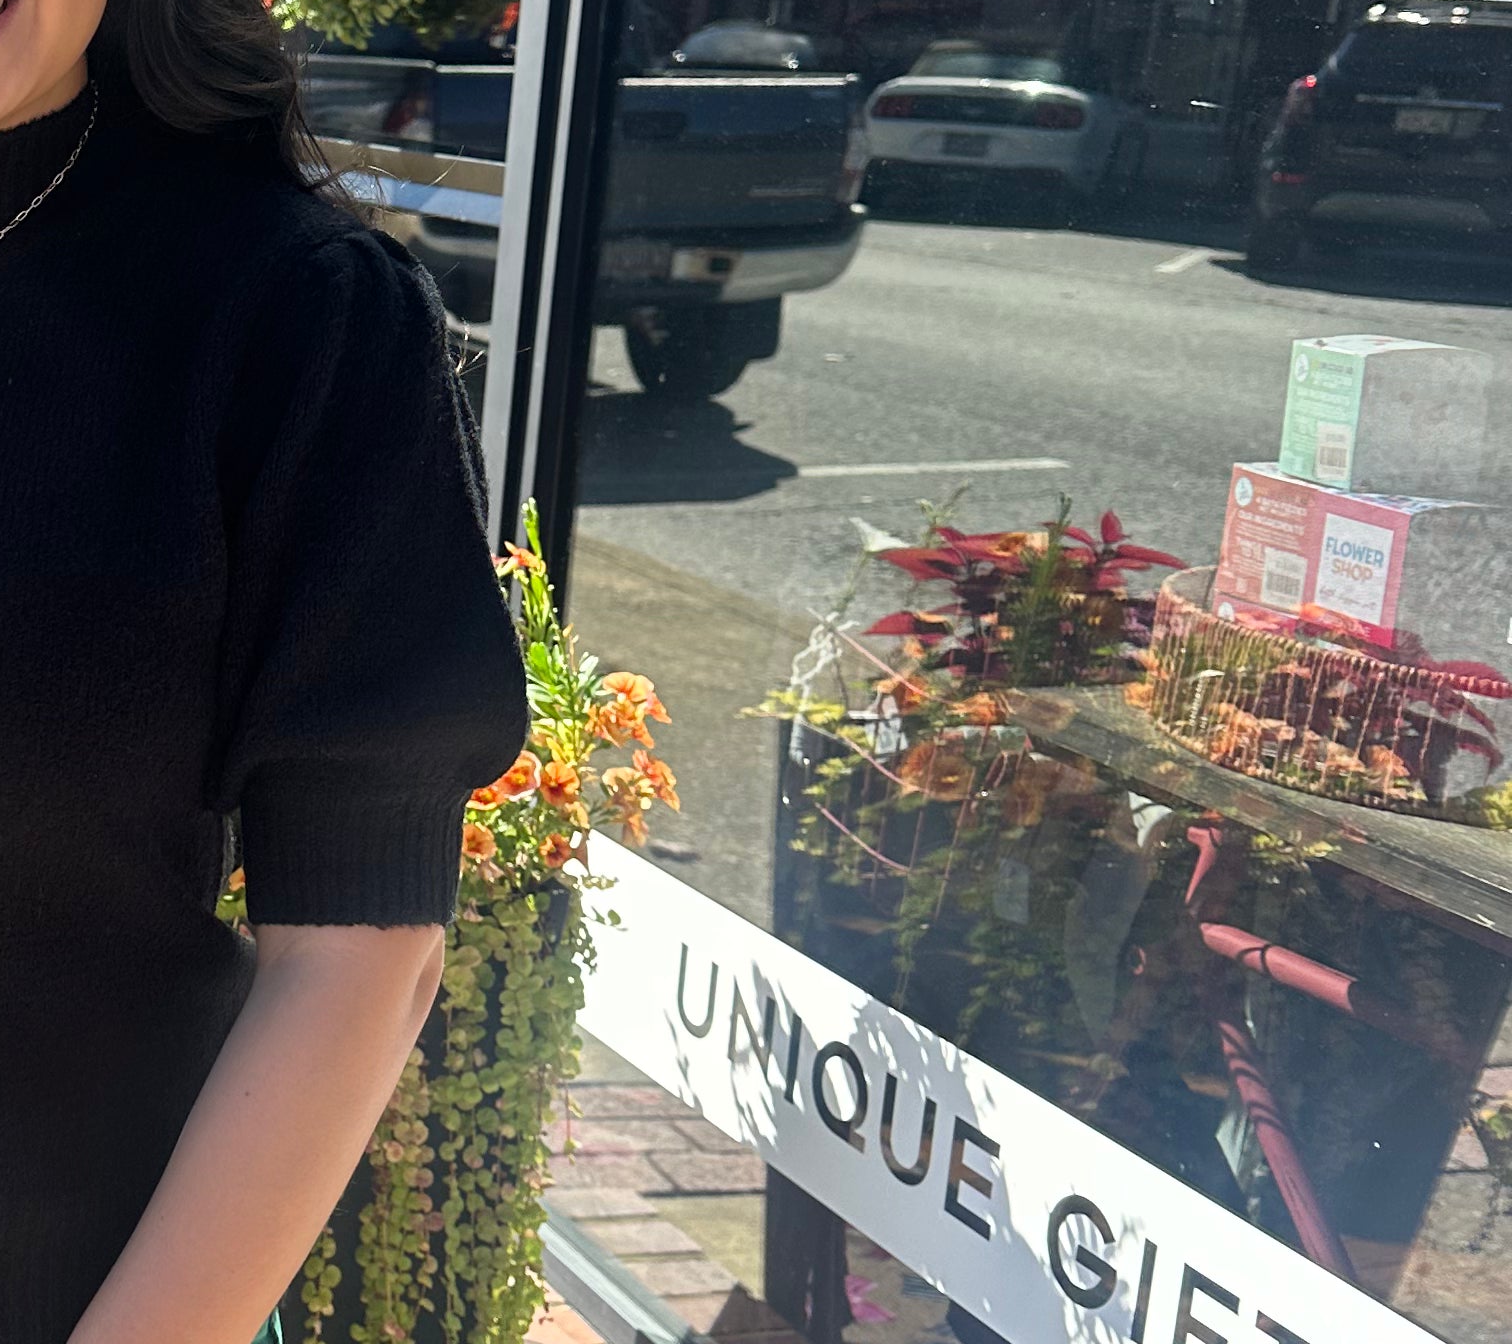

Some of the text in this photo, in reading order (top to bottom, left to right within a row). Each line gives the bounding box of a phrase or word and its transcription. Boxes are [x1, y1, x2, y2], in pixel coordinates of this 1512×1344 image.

[1325, 536, 1385, 568] FLOWER
[1331, 558, 1373, 582] SHOP
[676, 941, 1002, 1242] UNIQUE
